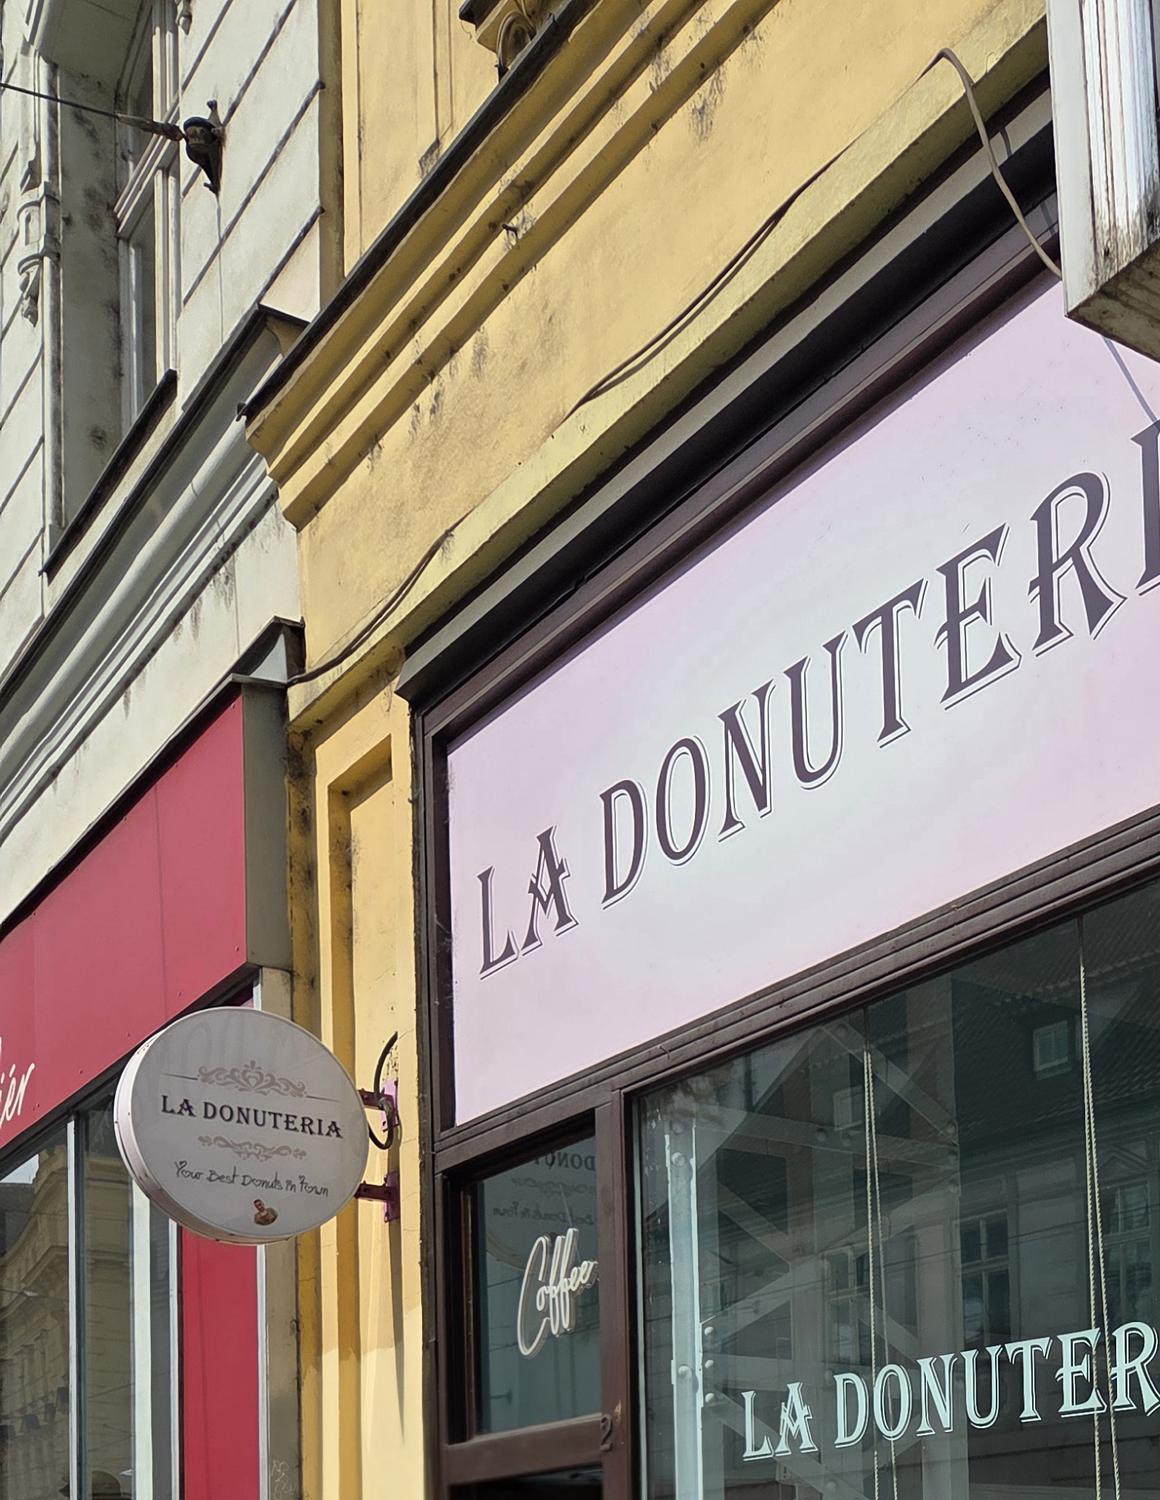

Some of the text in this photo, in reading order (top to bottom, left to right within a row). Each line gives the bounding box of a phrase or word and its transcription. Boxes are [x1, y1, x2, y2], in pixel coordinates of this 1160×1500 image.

[477, 825, 579, 980] LA
[161, 1095, 344, 1139] LA DONUTERIA
[174, 1160, 330, 1197] Your Best Donuts in Town
[517, 1228, 599, 1357] Coffee
[741, 1381, 818, 1462] LA
